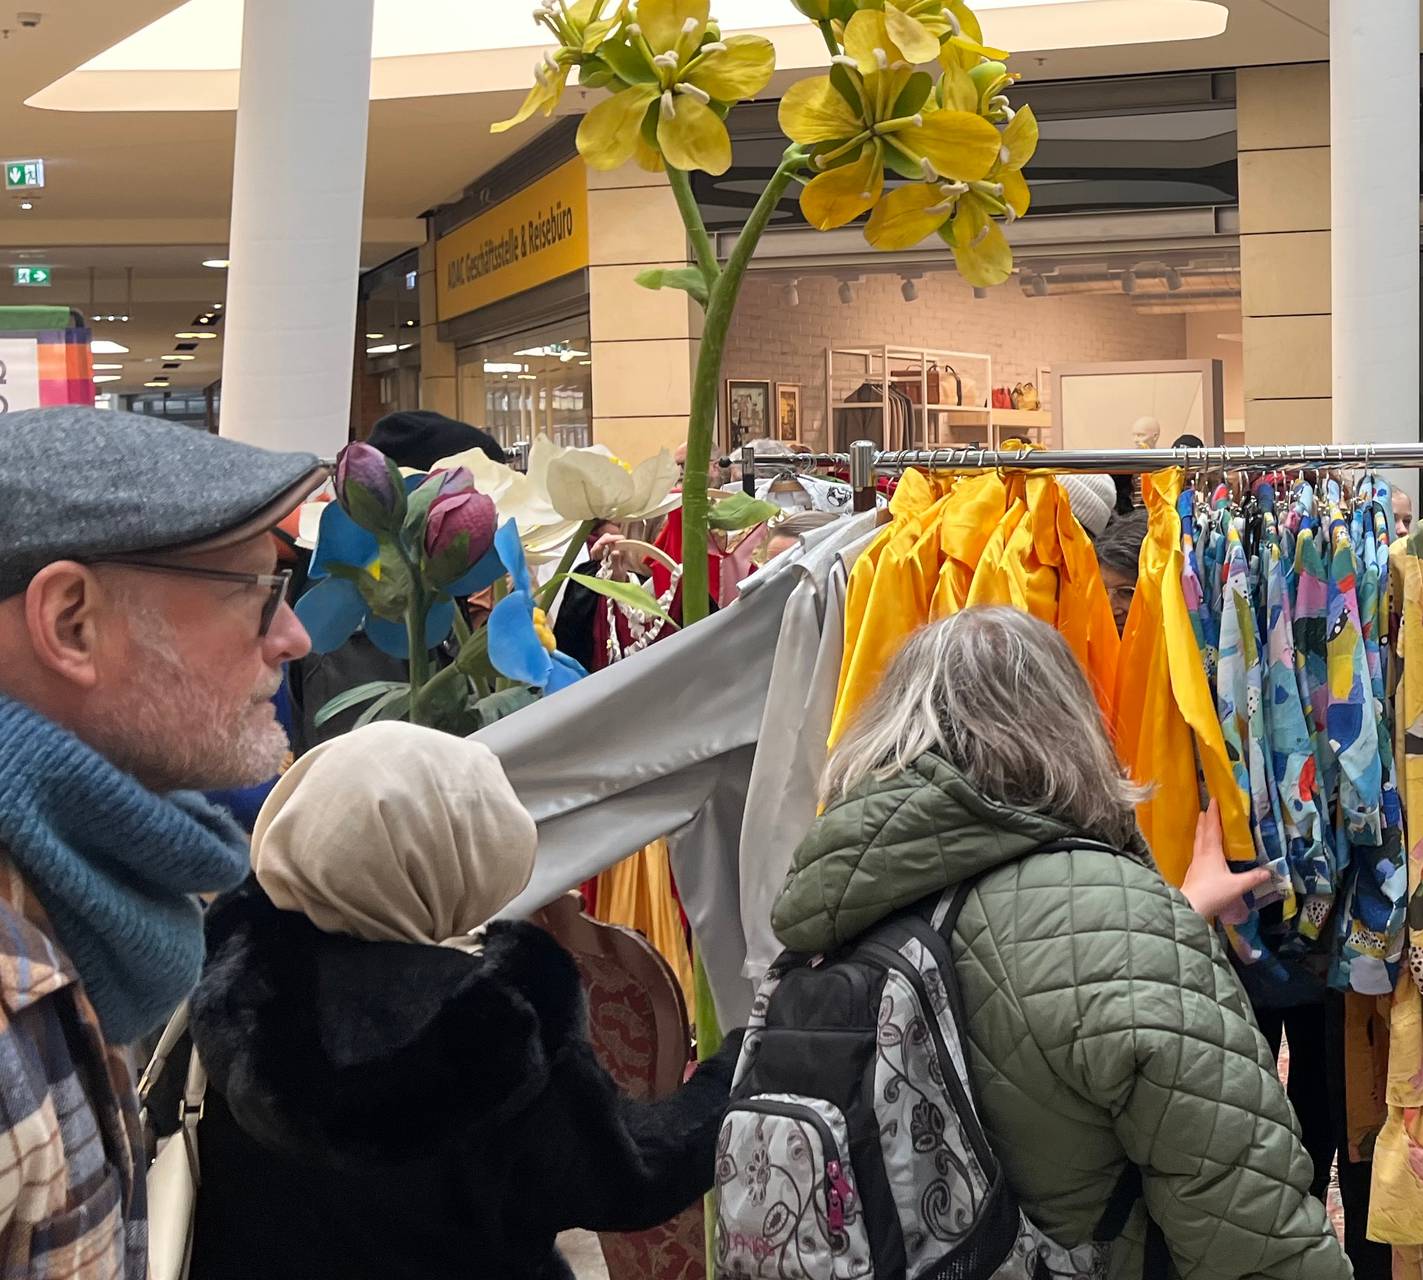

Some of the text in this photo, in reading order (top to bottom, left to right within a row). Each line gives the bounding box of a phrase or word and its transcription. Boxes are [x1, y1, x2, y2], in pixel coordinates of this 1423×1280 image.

[447, 200, 573, 289] ADAC Geschäftsstelle & Reisebüro
